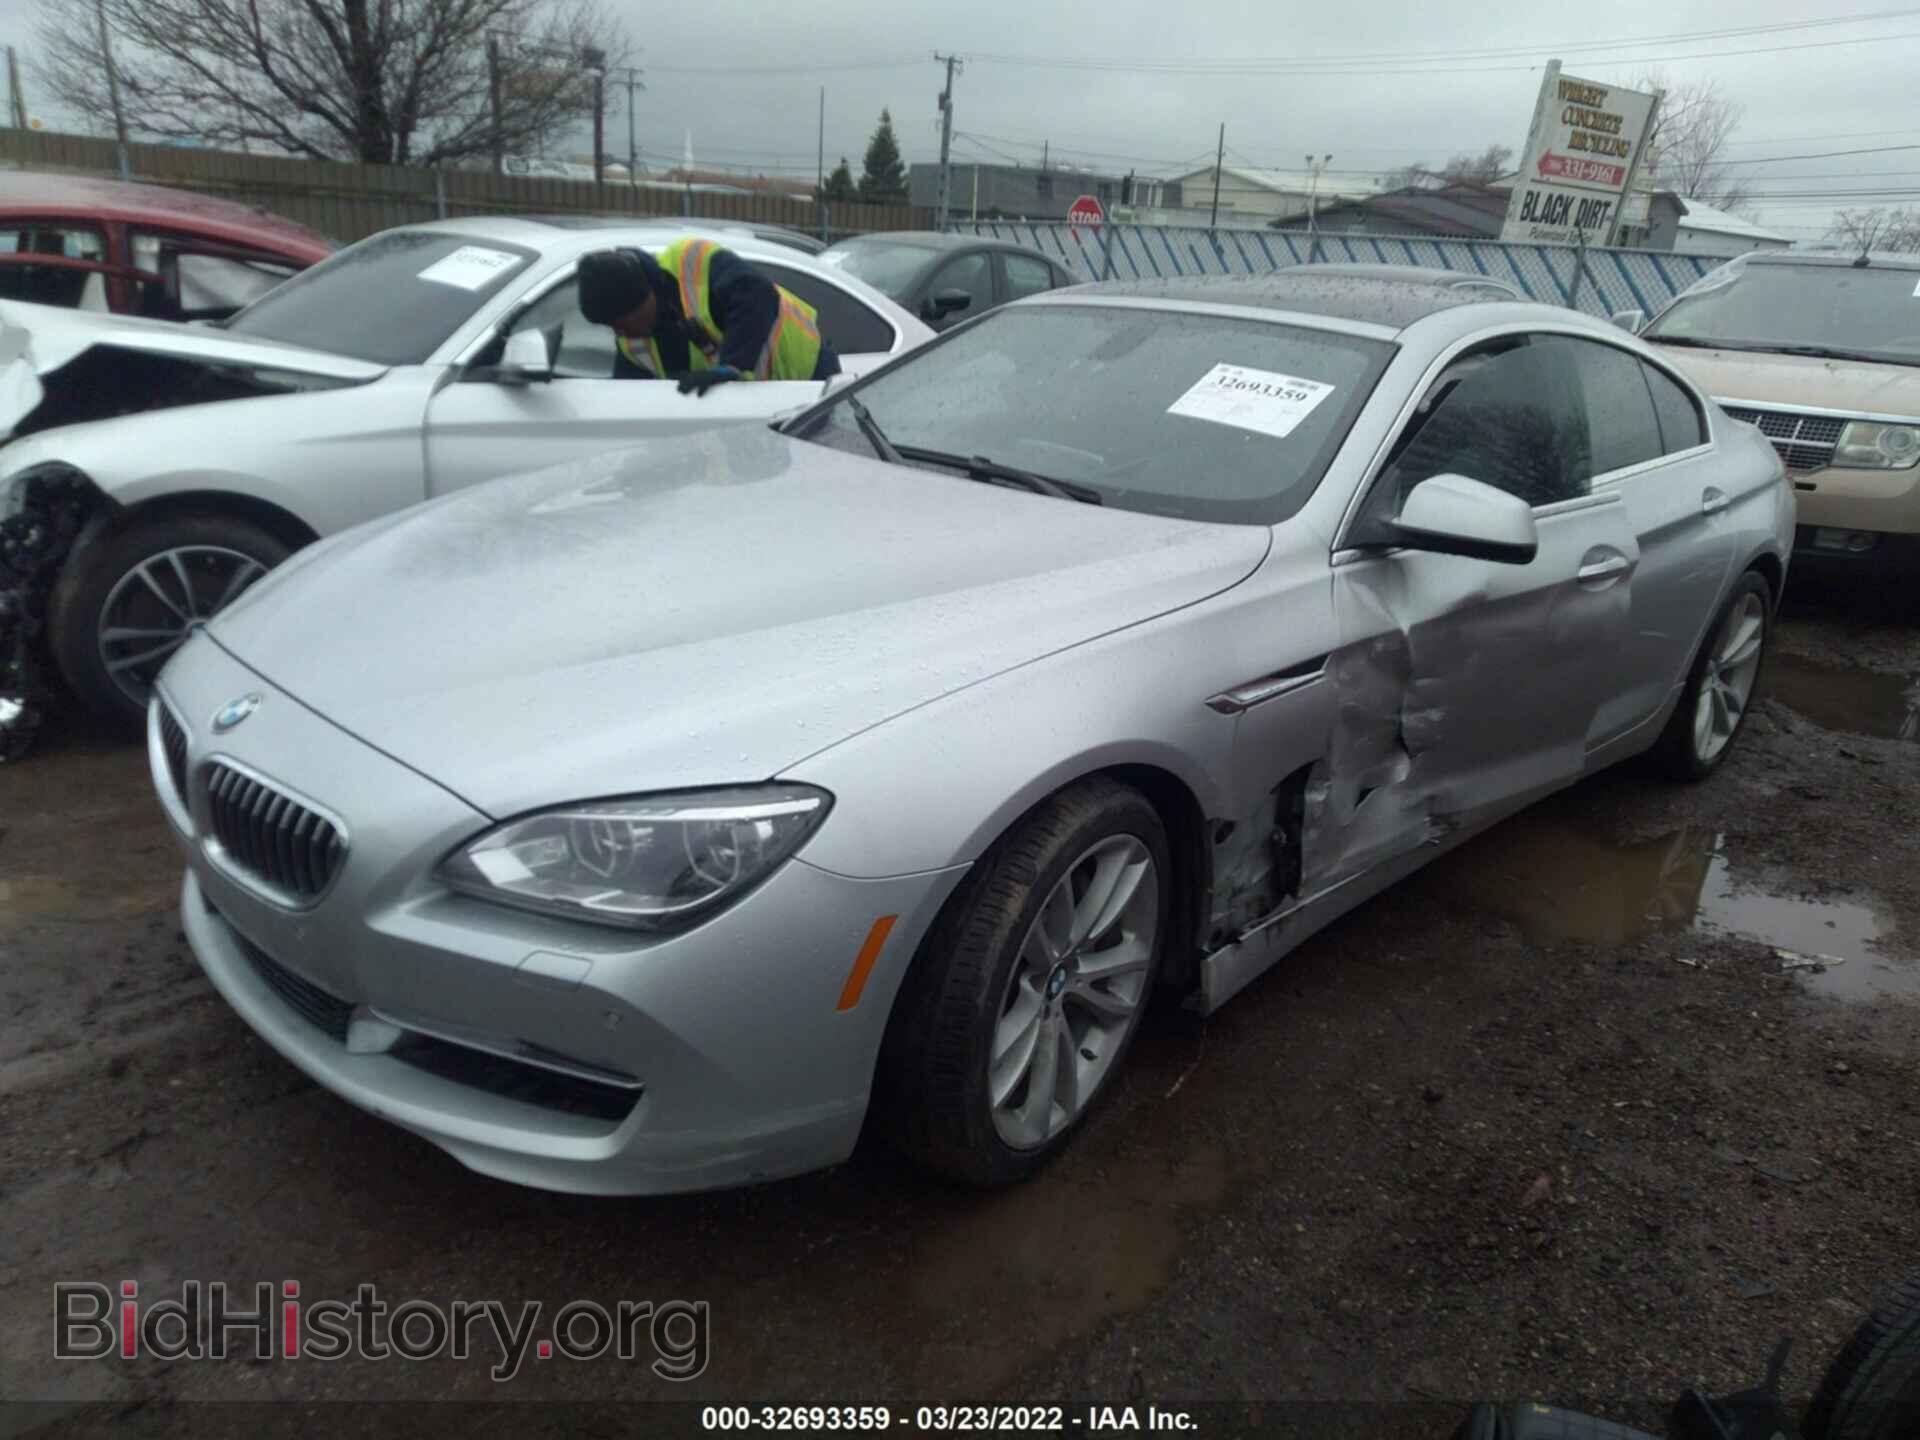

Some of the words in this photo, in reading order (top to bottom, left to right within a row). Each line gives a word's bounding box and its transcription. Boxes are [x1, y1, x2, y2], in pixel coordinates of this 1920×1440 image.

[1071, 210, 1101, 225] STOP
[1520, 190, 1576, 226] BLACK
[1574, 198, 1612, 229] DIRT
